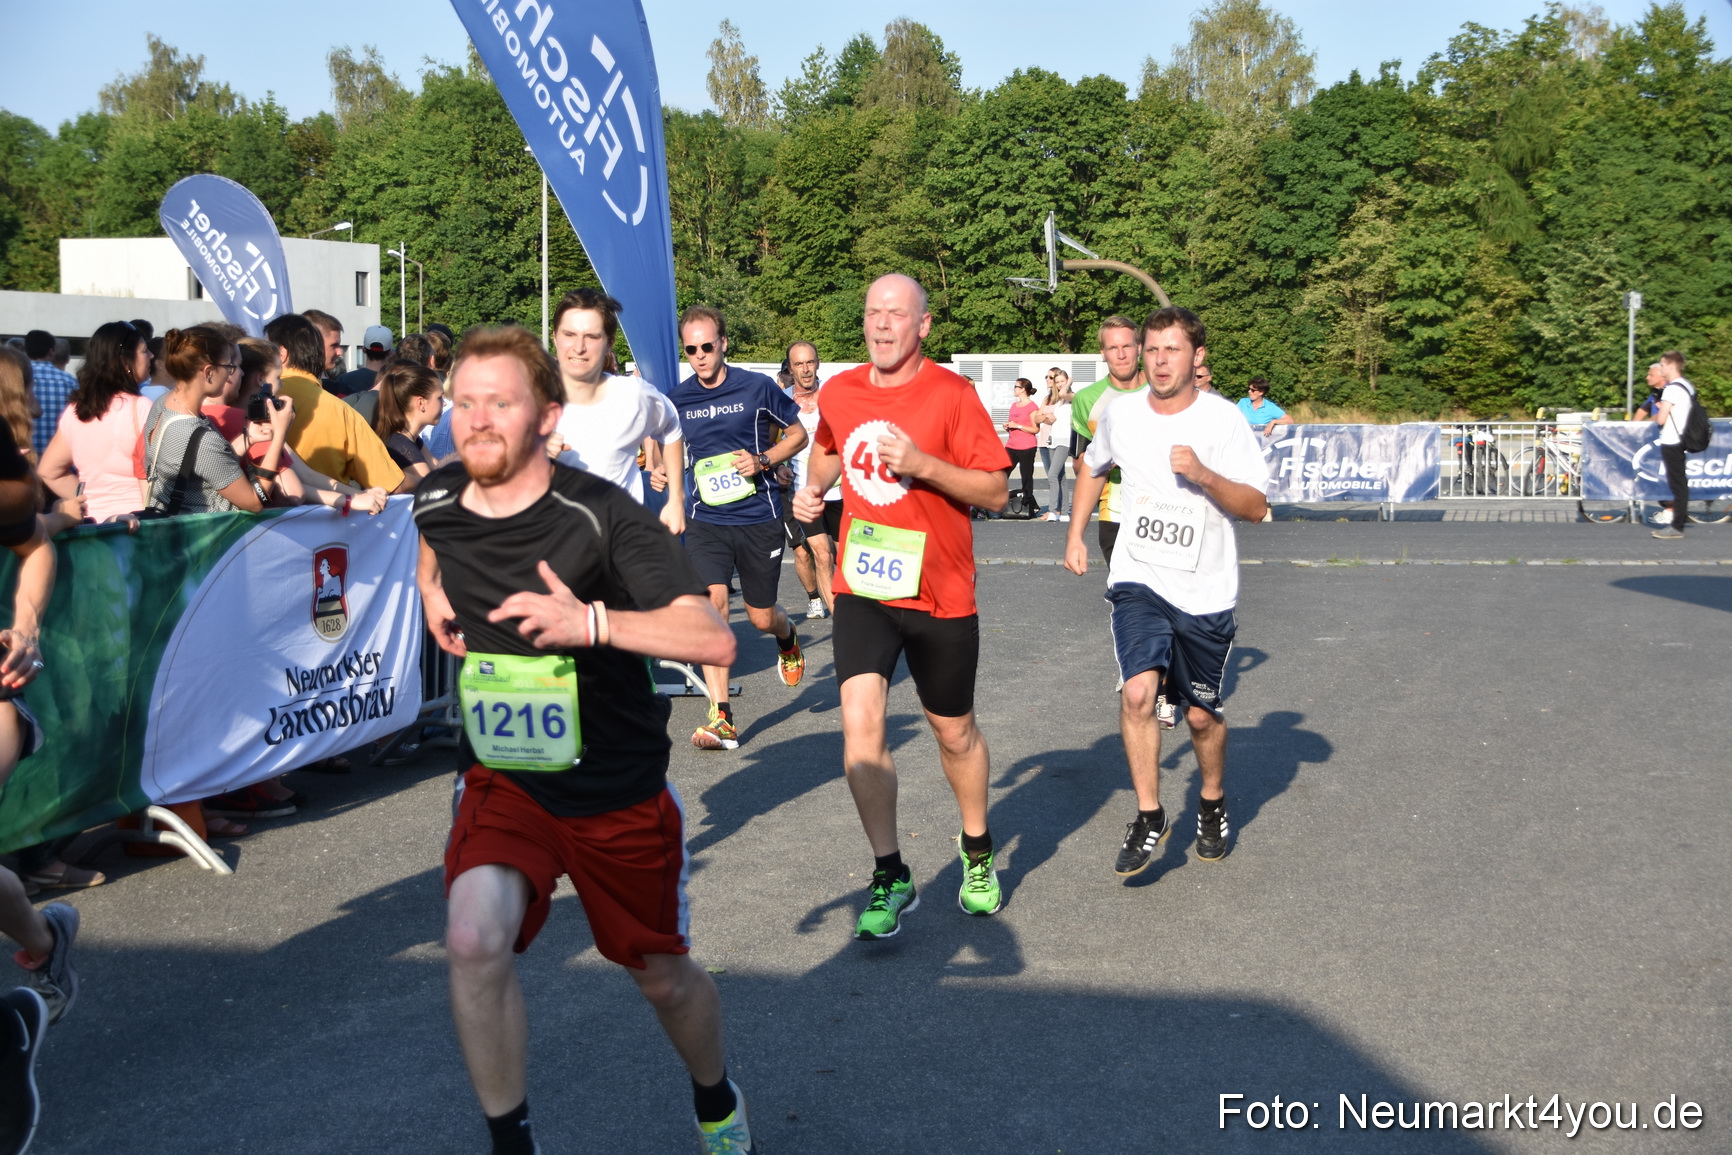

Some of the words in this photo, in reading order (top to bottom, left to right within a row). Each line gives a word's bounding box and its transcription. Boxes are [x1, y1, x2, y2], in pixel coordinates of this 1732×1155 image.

[1278, 456, 1391, 478] Fischer
[709, 471, 742, 492] 365
[1288, 480, 1383, 490] AUTOMOBILE
[253, 482, 268, 502] SONY
[1135, 495, 1195, 515] df-sports
[1135, 515, 1195, 548] 8930
[856, 551, 903, 582] 546
[322, 617, 342, 634] 1628
[471, 699, 567, 739] 1216
[492, 744, 520, 753] Michael
[521, 746, 545, 754] Herbst
